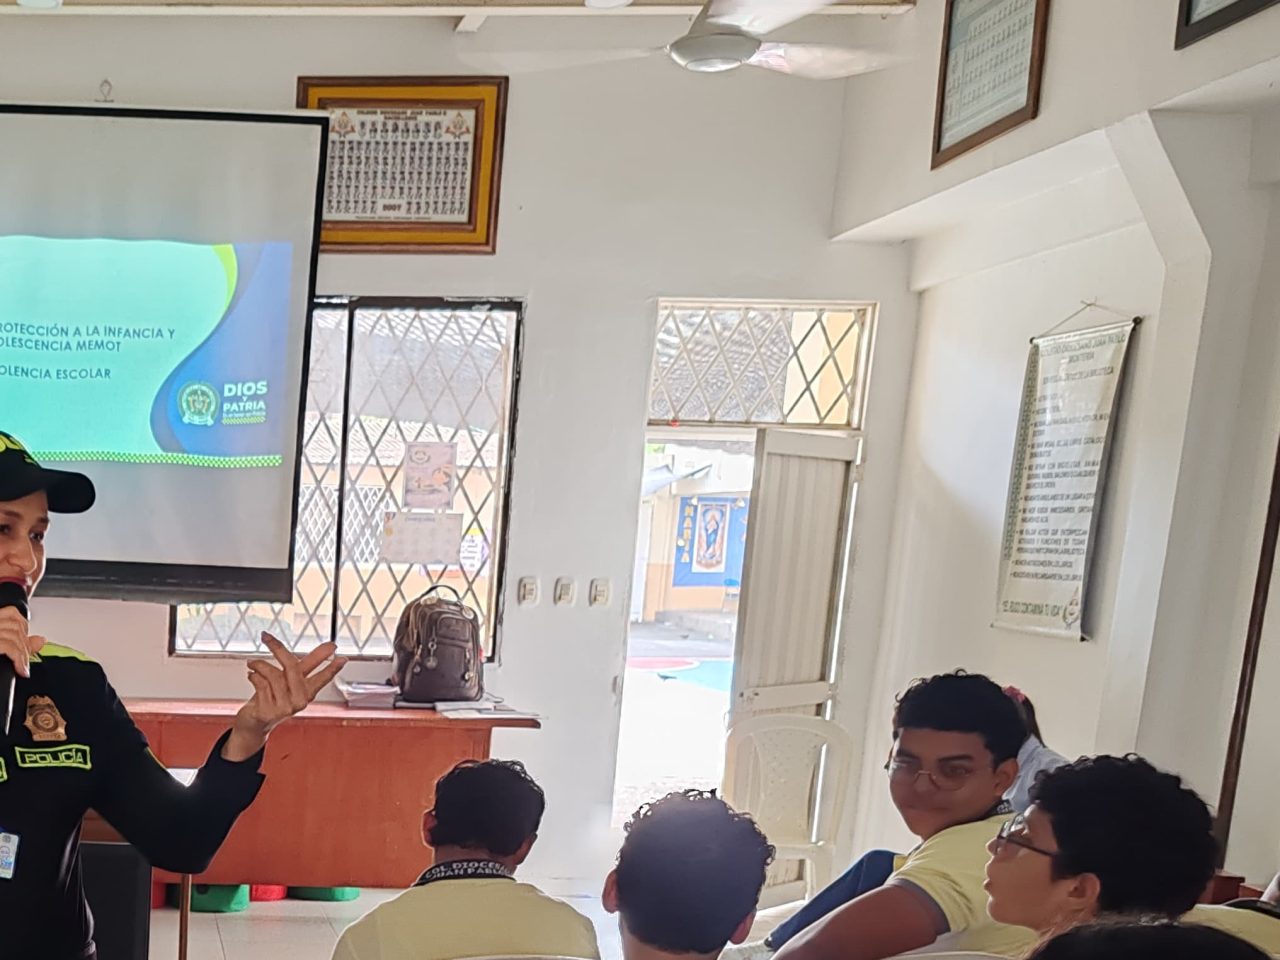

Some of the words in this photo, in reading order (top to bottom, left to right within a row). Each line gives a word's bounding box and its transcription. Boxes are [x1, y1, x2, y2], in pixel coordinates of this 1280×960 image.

[72, 325, 82, 338] A
[86, 325, 100, 337] LA
[104, 325, 164, 339] INFANCIA
[167, 328, 176, 340] Y
[76, 340, 121, 353] MEMOT
[56, 368, 111, 380] ESCOLAR
[223, 381, 268, 397] DIOS
[223, 401, 266, 412] PATRIA
[24, 748, 84, 764] POLICÍA
